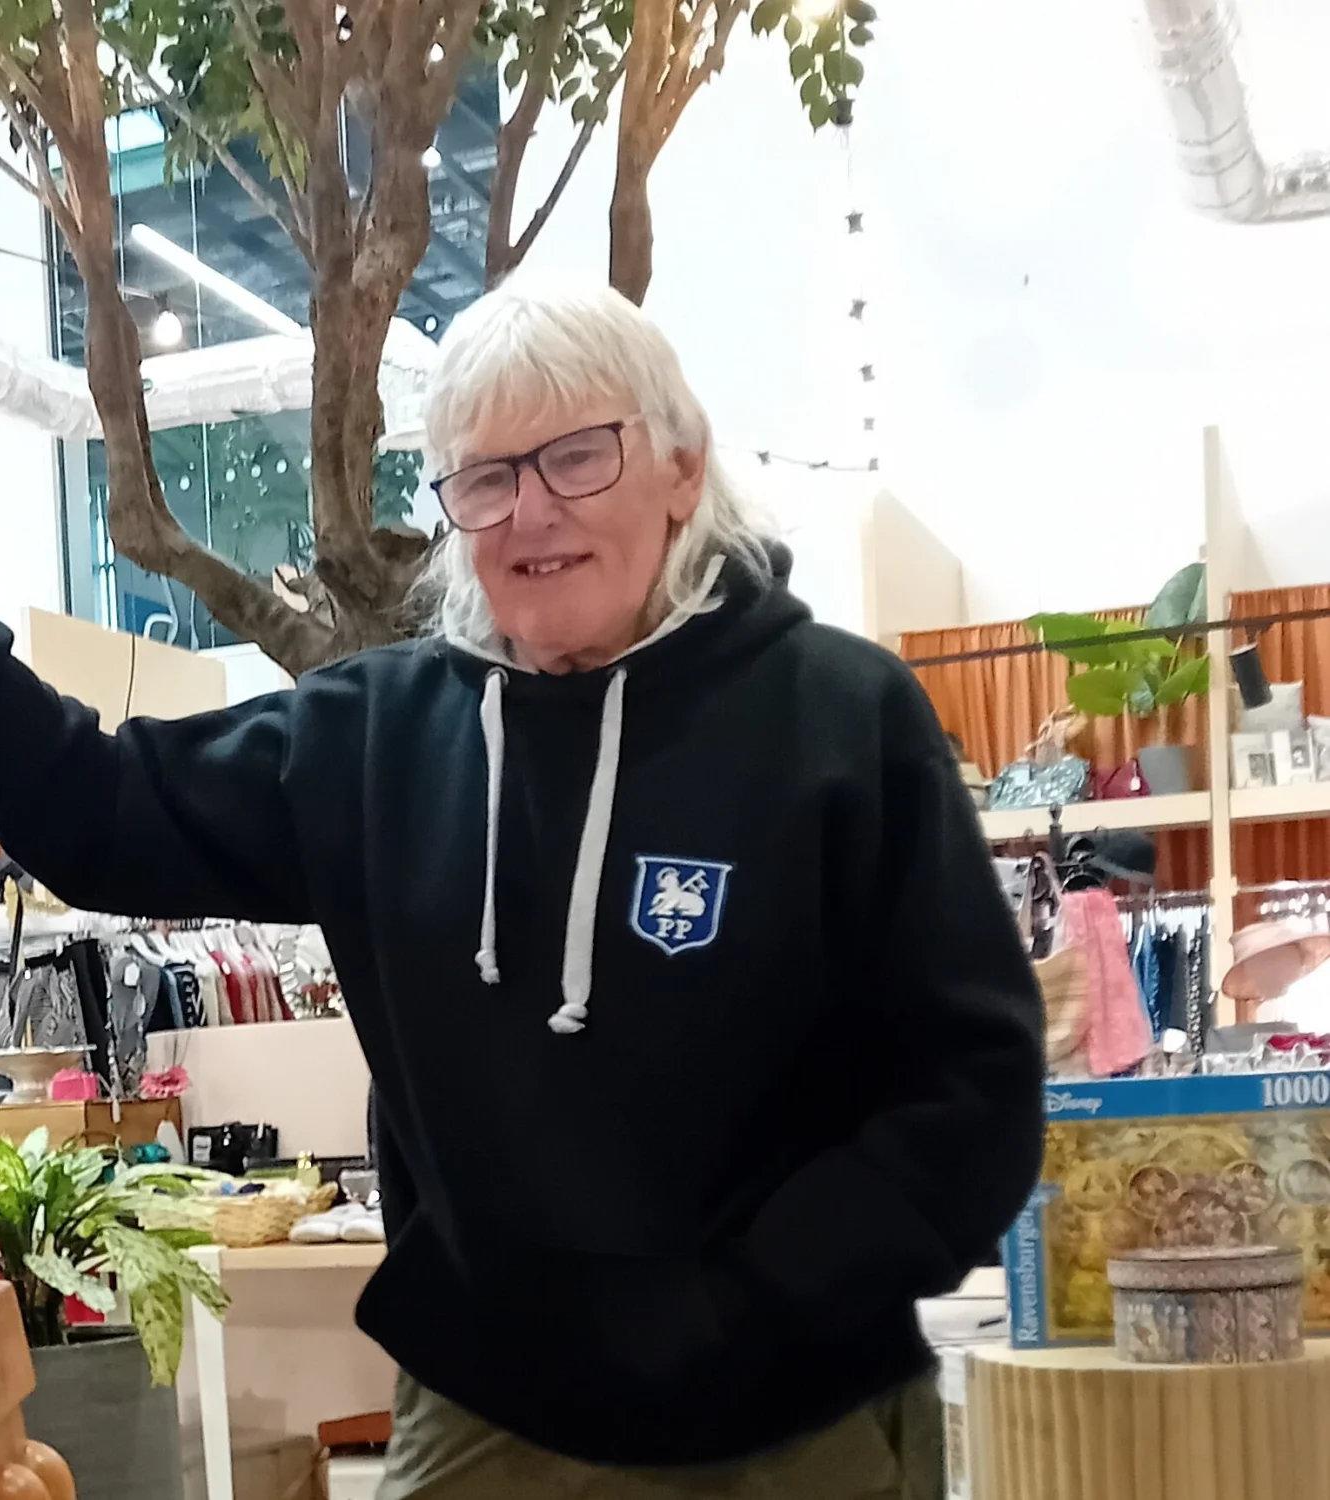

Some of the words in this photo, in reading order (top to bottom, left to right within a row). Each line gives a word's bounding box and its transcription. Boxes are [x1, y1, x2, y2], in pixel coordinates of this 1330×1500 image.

[1044, 1091, 1103, 1115] Disney
[1262, 1074, 1330, 1107] 1000
[1017, 1207, 1040, 1342] Ravensburger
